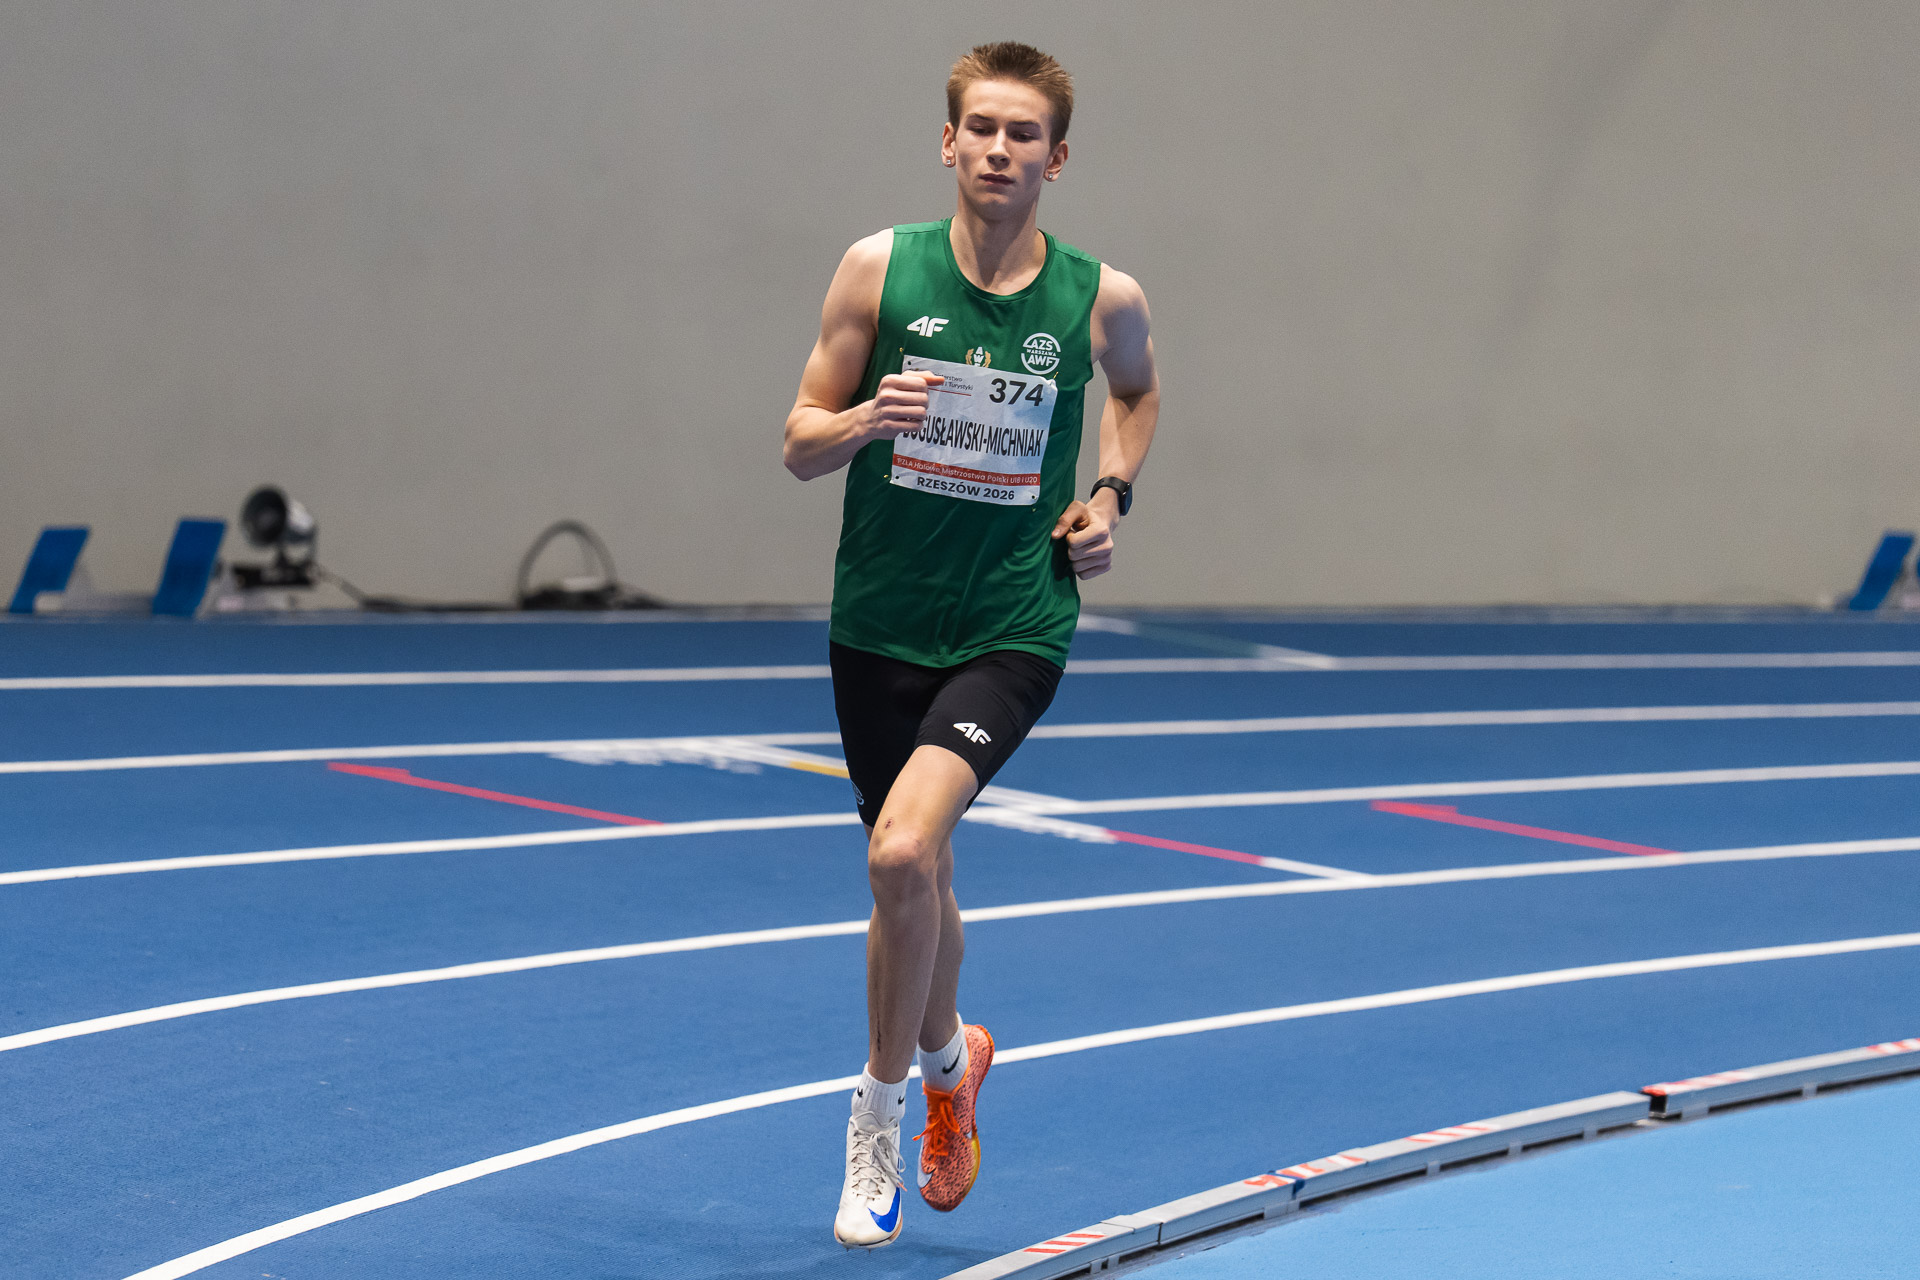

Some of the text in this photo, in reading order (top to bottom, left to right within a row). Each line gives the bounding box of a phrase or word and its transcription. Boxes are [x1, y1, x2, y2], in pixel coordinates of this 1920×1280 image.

[907, 315, 950, 338] 4F
[1026, 349, 1057, 357] WARSZAWA
[1031, 339, 1053, 351] AZS
[1027, 354, 1054, 367] AWF
[949, 381, 974, 391] Turystyki
[989, 377, 1044, 407] 374
[903, 414, 1044, 457] GUSŁAWSKI-MICHNIAK
[942, 467, 986, 481] Mistrzostwa
[987, 475, 1009, 484] Polski
[1025, 476, 1038, 484] U20
[917, 477, 1015, 500] RZESZÓW 2026
[953, 722, 992, 745] 4F
